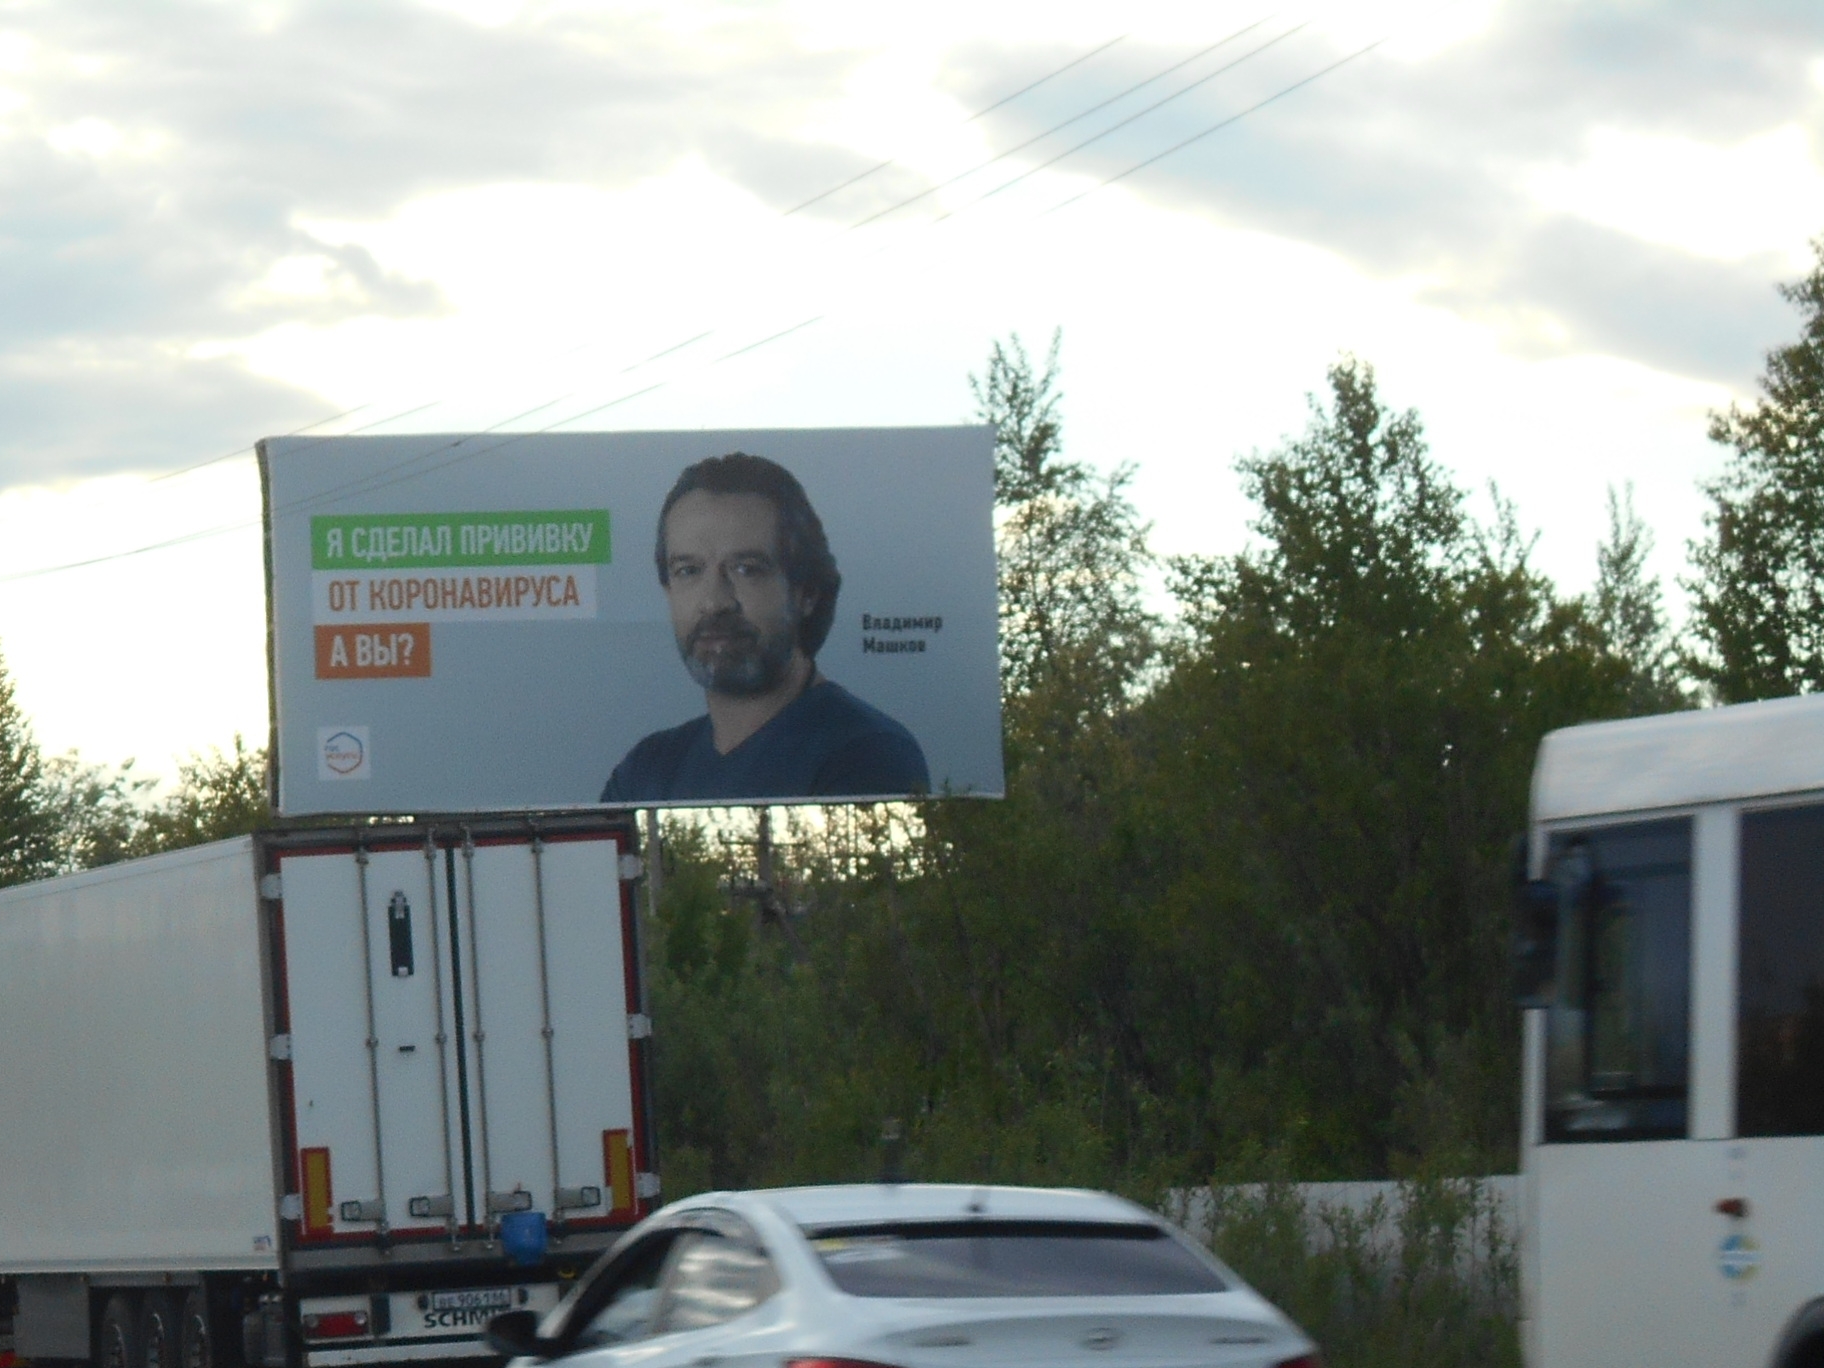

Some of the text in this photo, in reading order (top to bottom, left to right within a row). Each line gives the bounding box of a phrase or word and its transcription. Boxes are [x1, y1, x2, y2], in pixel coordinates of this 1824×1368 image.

[327, 521, 595, 562] Я СДЕЛАЛ ПРИВИВКУ
[328, 574, 580, 612] ОТ КОРОНАВИРУСА
[862, 613, 944, 633] Владимир
[330, 632, 415, 667] А ВЫ?
[862, 636, 927, 653] Машков
[424, 1310, 498, 1328] SCHM
